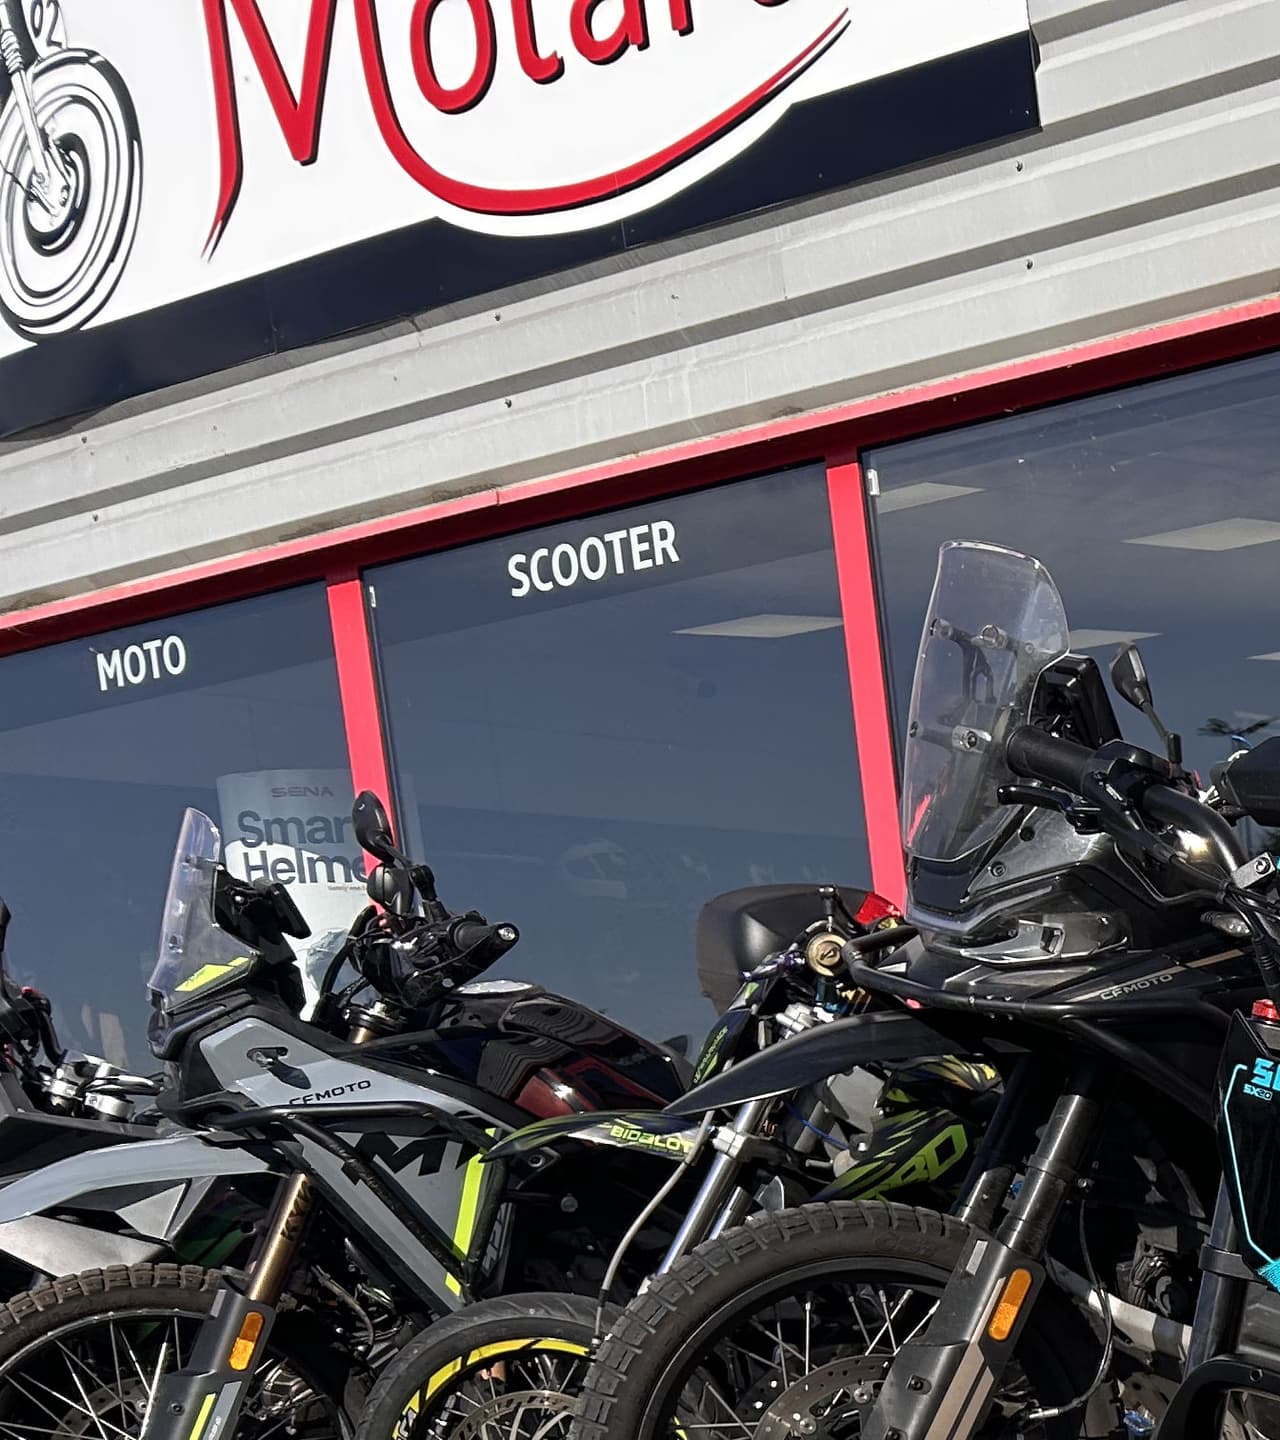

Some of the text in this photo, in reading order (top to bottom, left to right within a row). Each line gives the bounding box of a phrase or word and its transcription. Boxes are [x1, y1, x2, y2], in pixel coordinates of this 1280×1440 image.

[506, 519, 681, 597] SCOOTER
[97, 635, 187, 690] MOTO
[271, 786, 334, 798] SENA
[237, 810, 353, 848] Smar
[243, 848, 371, 885] Helme
[1100, 974, 1174, 1000] CFMOTO
